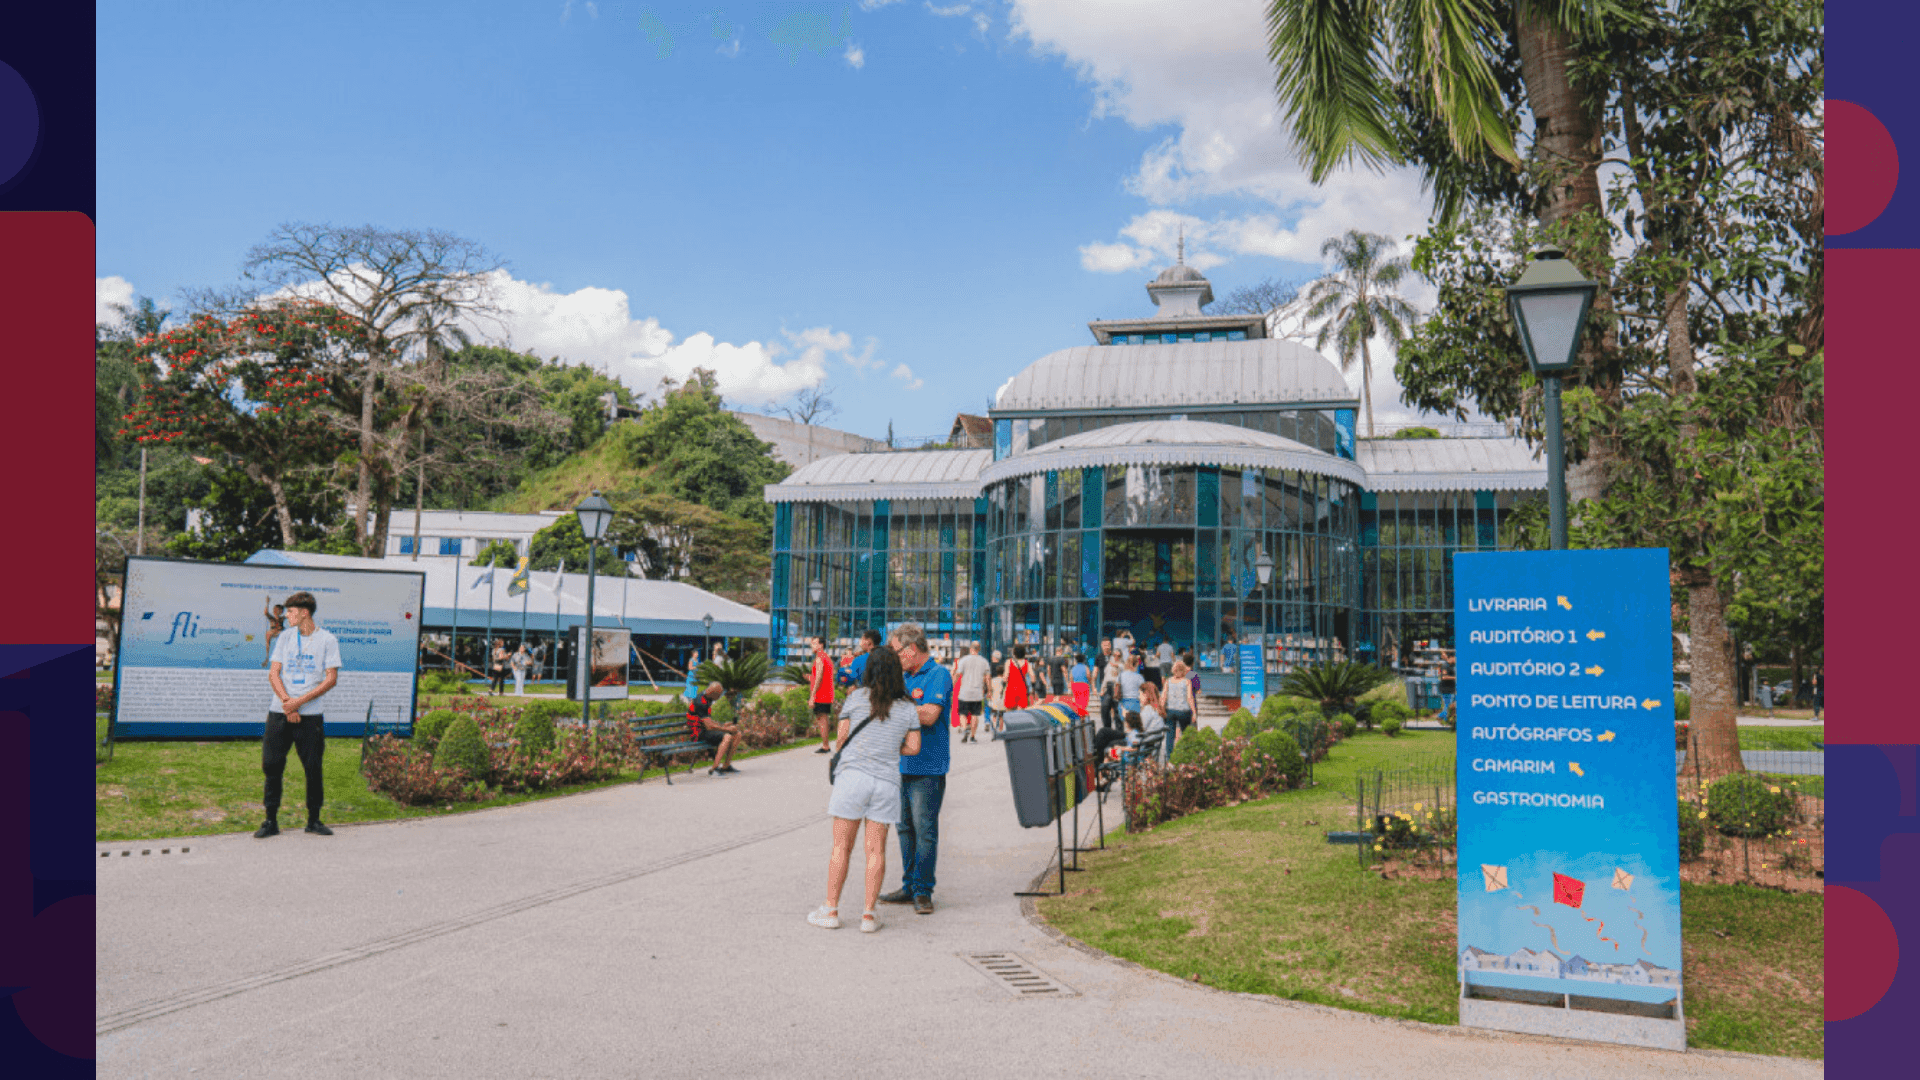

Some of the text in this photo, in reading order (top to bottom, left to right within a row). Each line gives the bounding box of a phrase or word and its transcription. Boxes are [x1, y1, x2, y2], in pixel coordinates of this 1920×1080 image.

[1469, 598, 1546, 611] LIVRARIA
[164, 611, 200, 645] fli
[1470, 627, 1577, 643] AUDITÓRIO 1
[336, 636, 377, 645] RIANÇAS
[1471, 659, 1579, 676] AUDITÓRIO 2
[1472, 694, 1636, 709] PONTO DE LEITURA
[1472, 724, 1592, 742] AUTÓGRAFOS
[1473, 759, 1555, 773] CAMARIM
[1473, 791, 1604, 808] GASTRONOMIA
